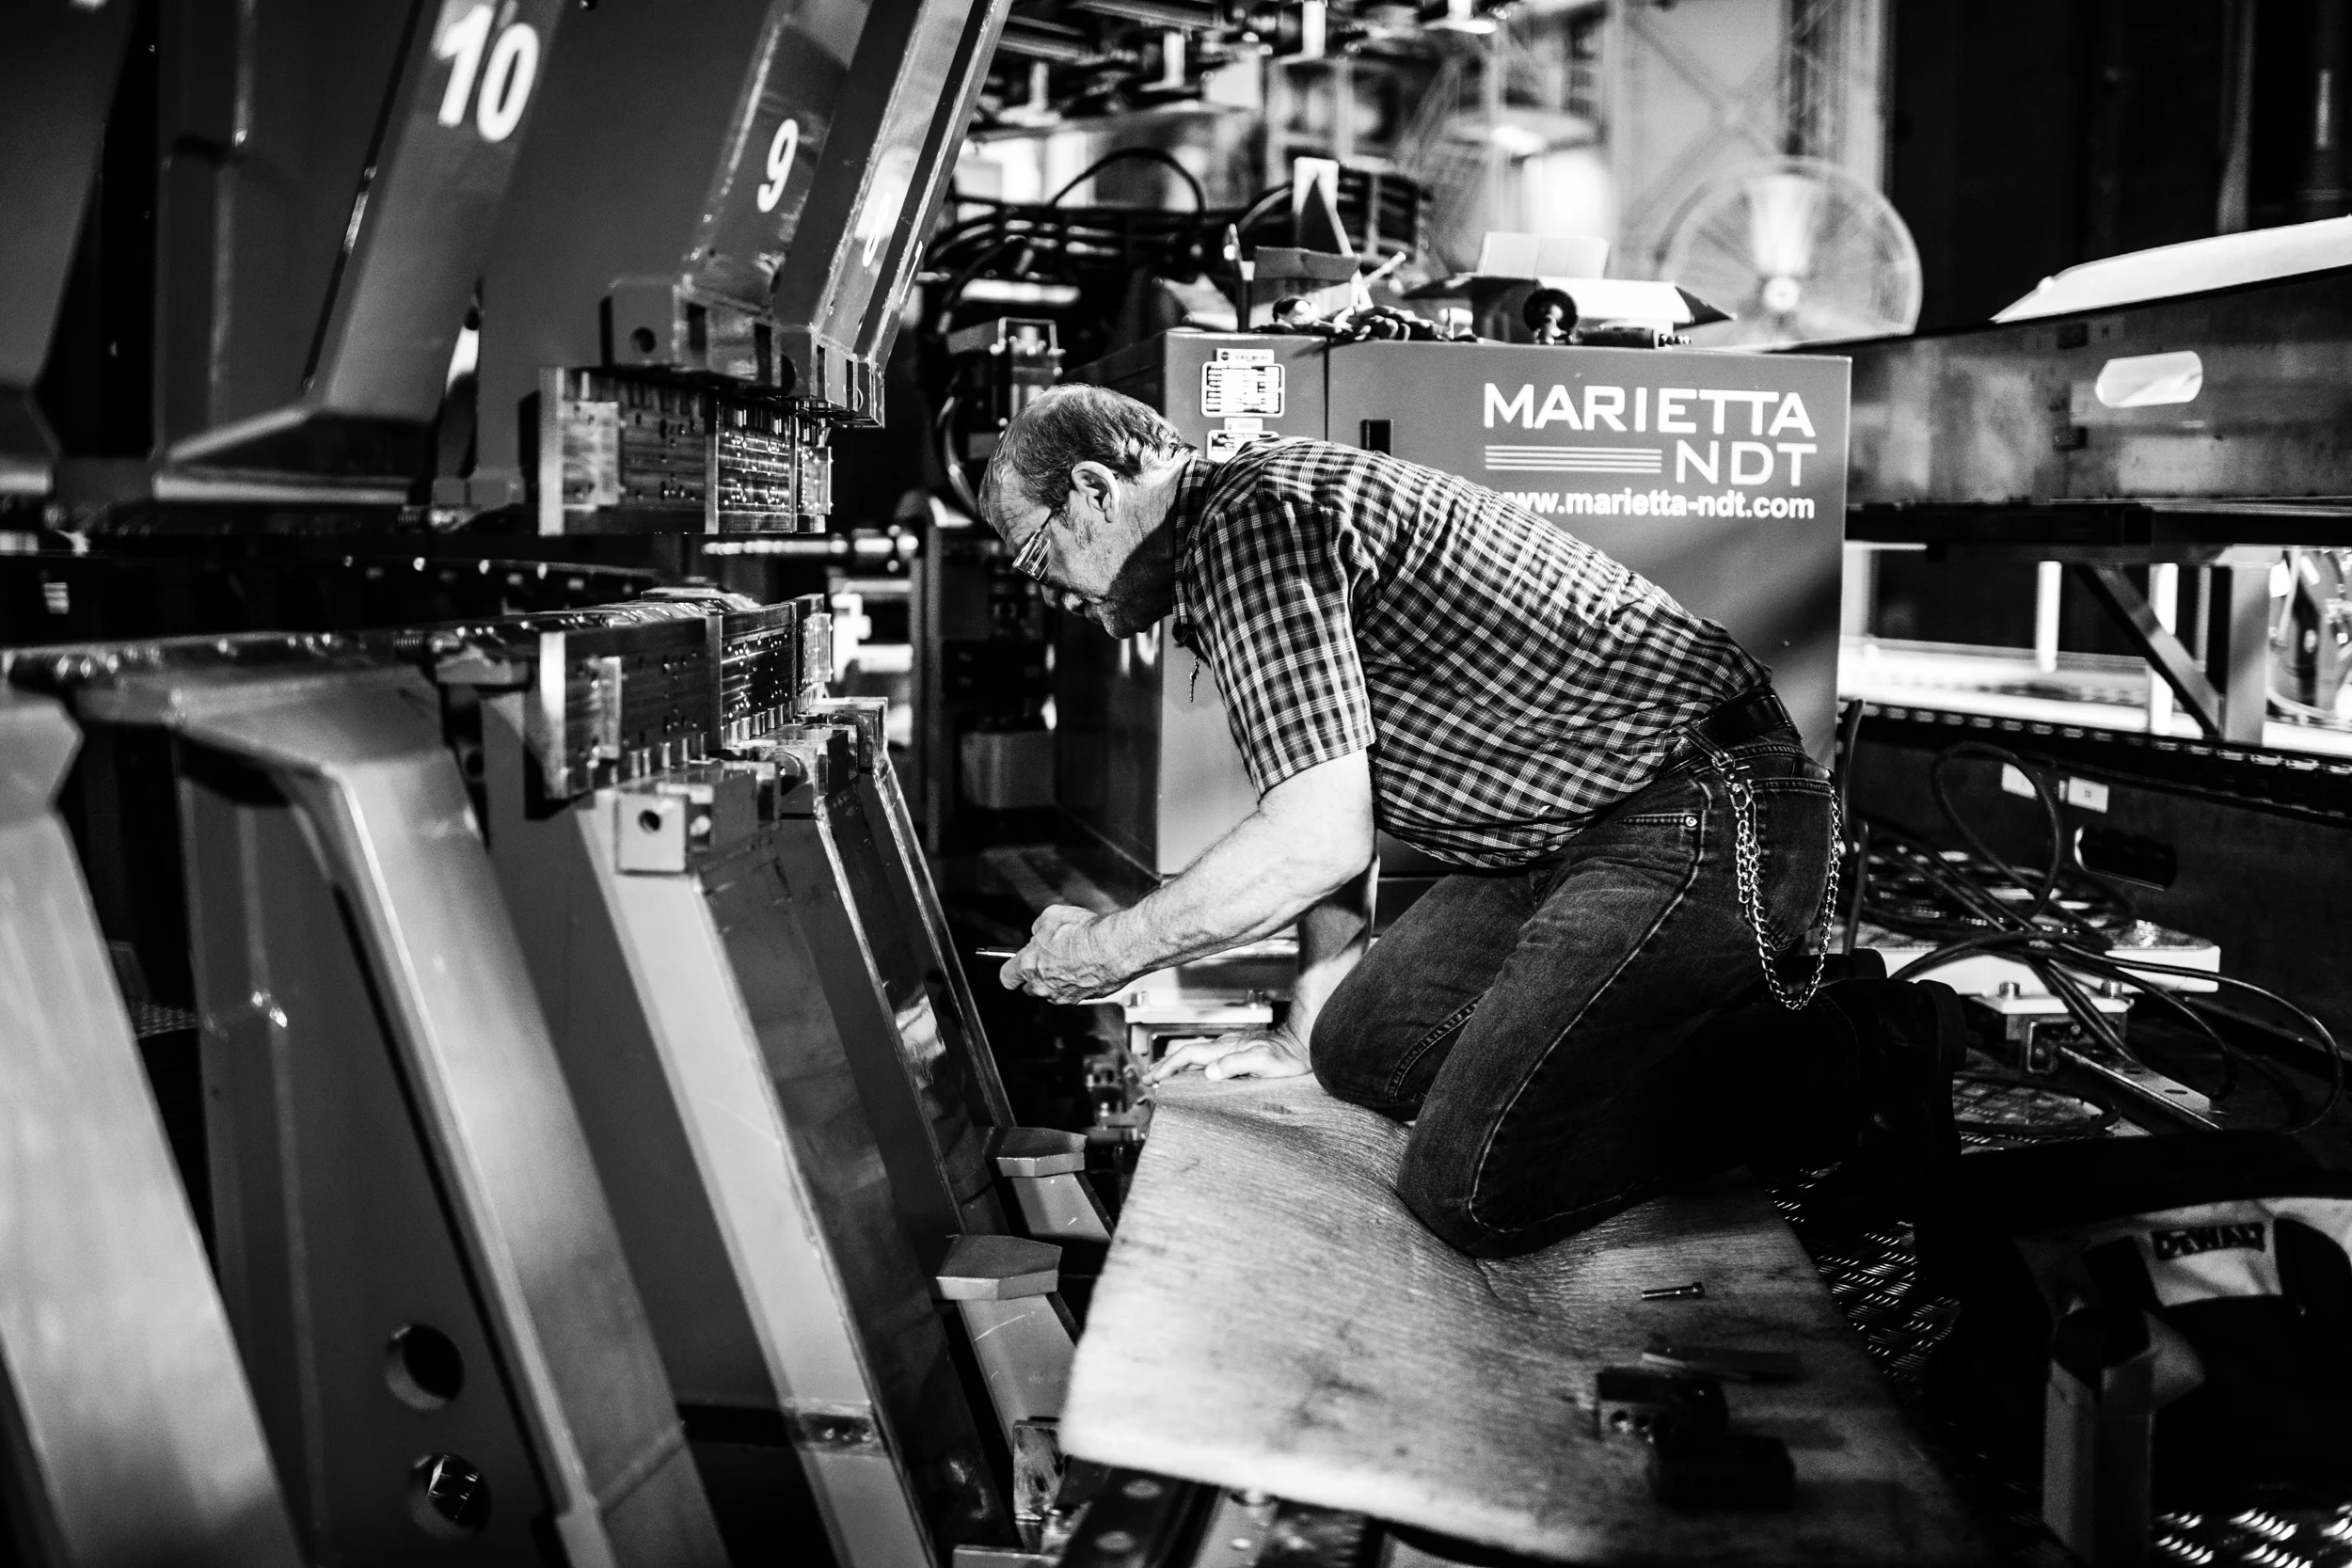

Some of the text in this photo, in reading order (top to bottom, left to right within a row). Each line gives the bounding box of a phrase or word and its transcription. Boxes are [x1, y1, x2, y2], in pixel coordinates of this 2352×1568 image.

[438, 5, 539, 142] 10
[757, 119, 799, 213] 9
[863, 192, 892, 267] 8
[1484, 382, 1816, 437] MARIETTA
[1676, 439, 1818, 486] NDT
[1496, 487, 1815, 519] ww.marietta-ndt.com
